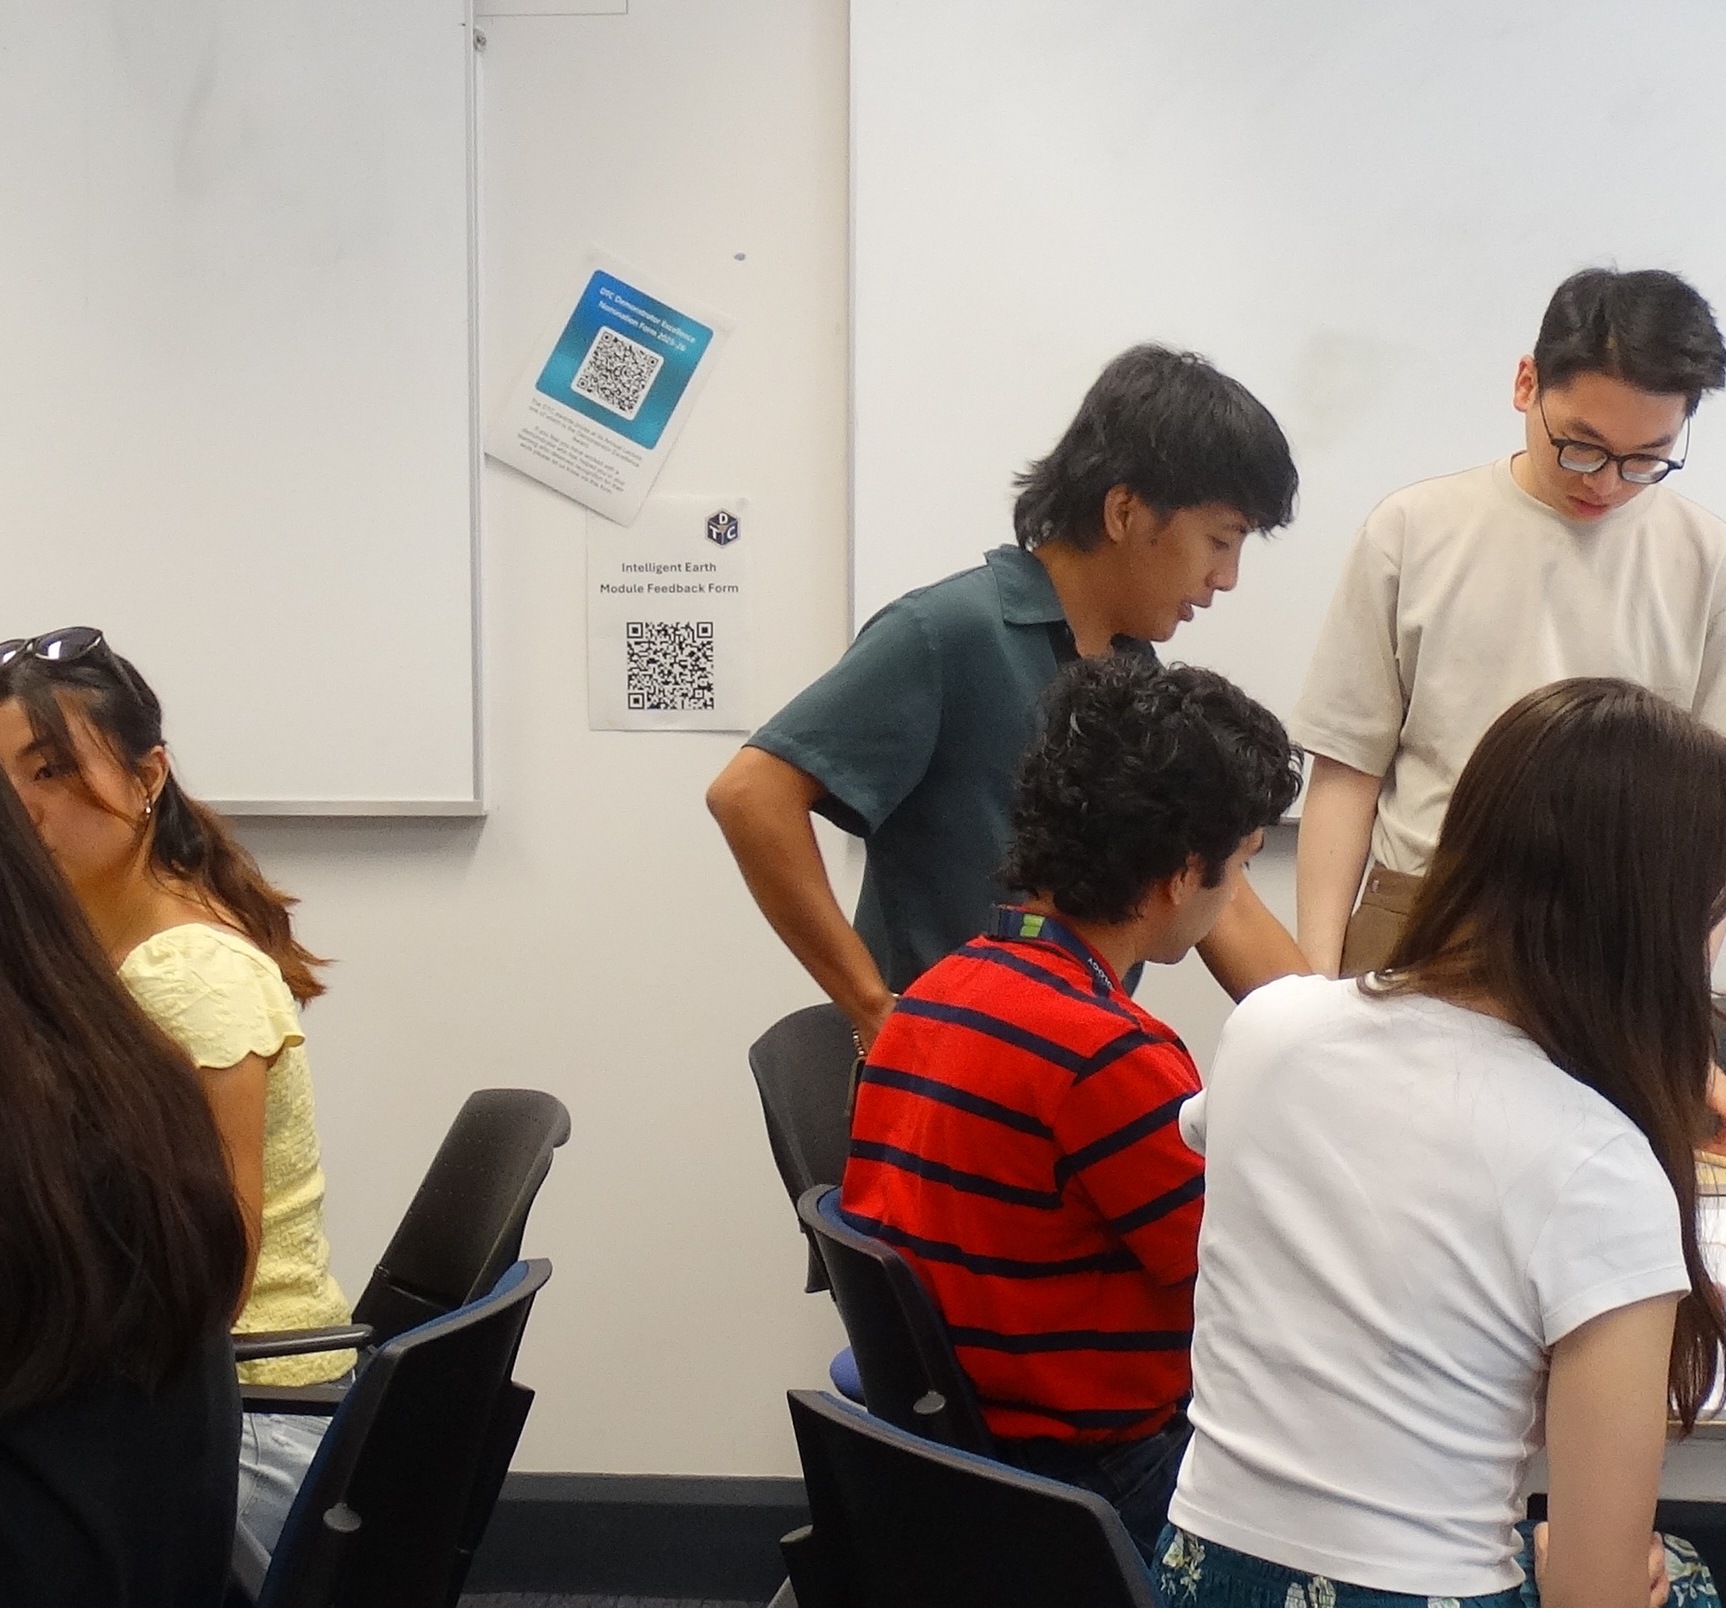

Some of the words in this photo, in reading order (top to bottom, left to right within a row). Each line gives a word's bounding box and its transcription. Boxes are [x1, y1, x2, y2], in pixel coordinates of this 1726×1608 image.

[621, 562, 682, 574] Intelligent
[685, 562, 717, 572] Earth
[600, 584, 644, 593] Module
[647, 583, 705, 593] Feedback
[708, 583, 739, 593] Form
